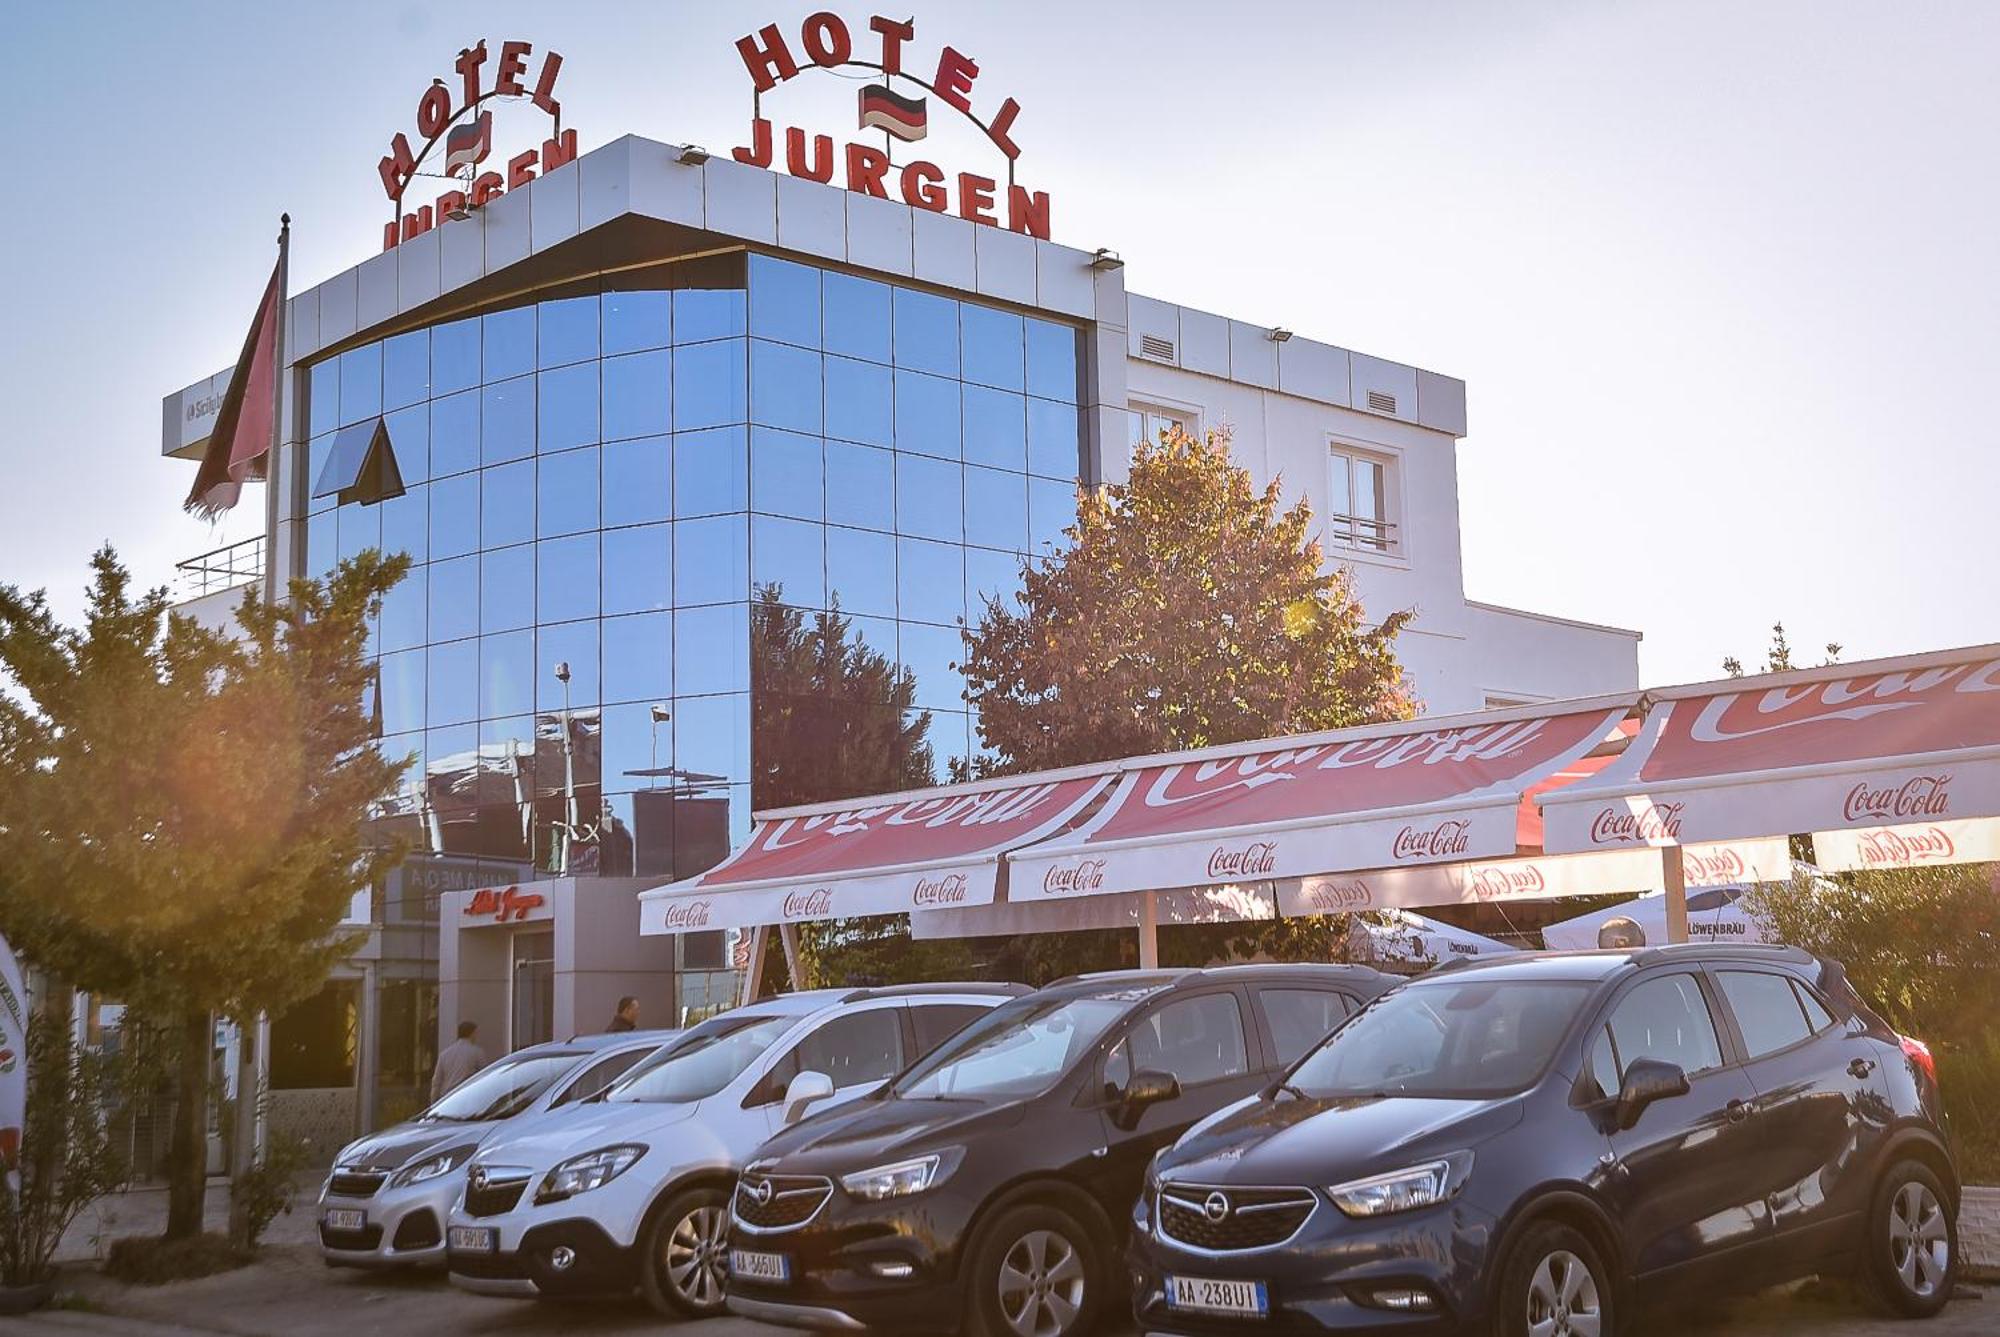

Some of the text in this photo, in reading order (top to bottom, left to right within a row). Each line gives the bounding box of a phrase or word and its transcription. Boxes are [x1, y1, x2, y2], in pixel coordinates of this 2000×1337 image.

[735, 11, 1020, 160] HOTEL
[378, 40, 563, 200] HOTEL
[732, 119, 1050, 240] JURGEN
[1843, 775, 1952, 821] Coca-Cola
[1393, 819, 1471, 859] Coca-Cola
[1591, 801, 1684, 843] Coca-Cola
[1043, 859, 1106, 892] Coca-Cola
[1207, 842, 1278, 877] Coca-Cola
[783, 889, 832, 917] Coca-Cola
[913, 874, 967, 904] Coca-Cola
[665, 901, 711, 928] Coca-Cola
[1687, 922, 1745, 935] LÖWENBRÄU
[1178, 1280, 1253, 1308] AA 238UI
